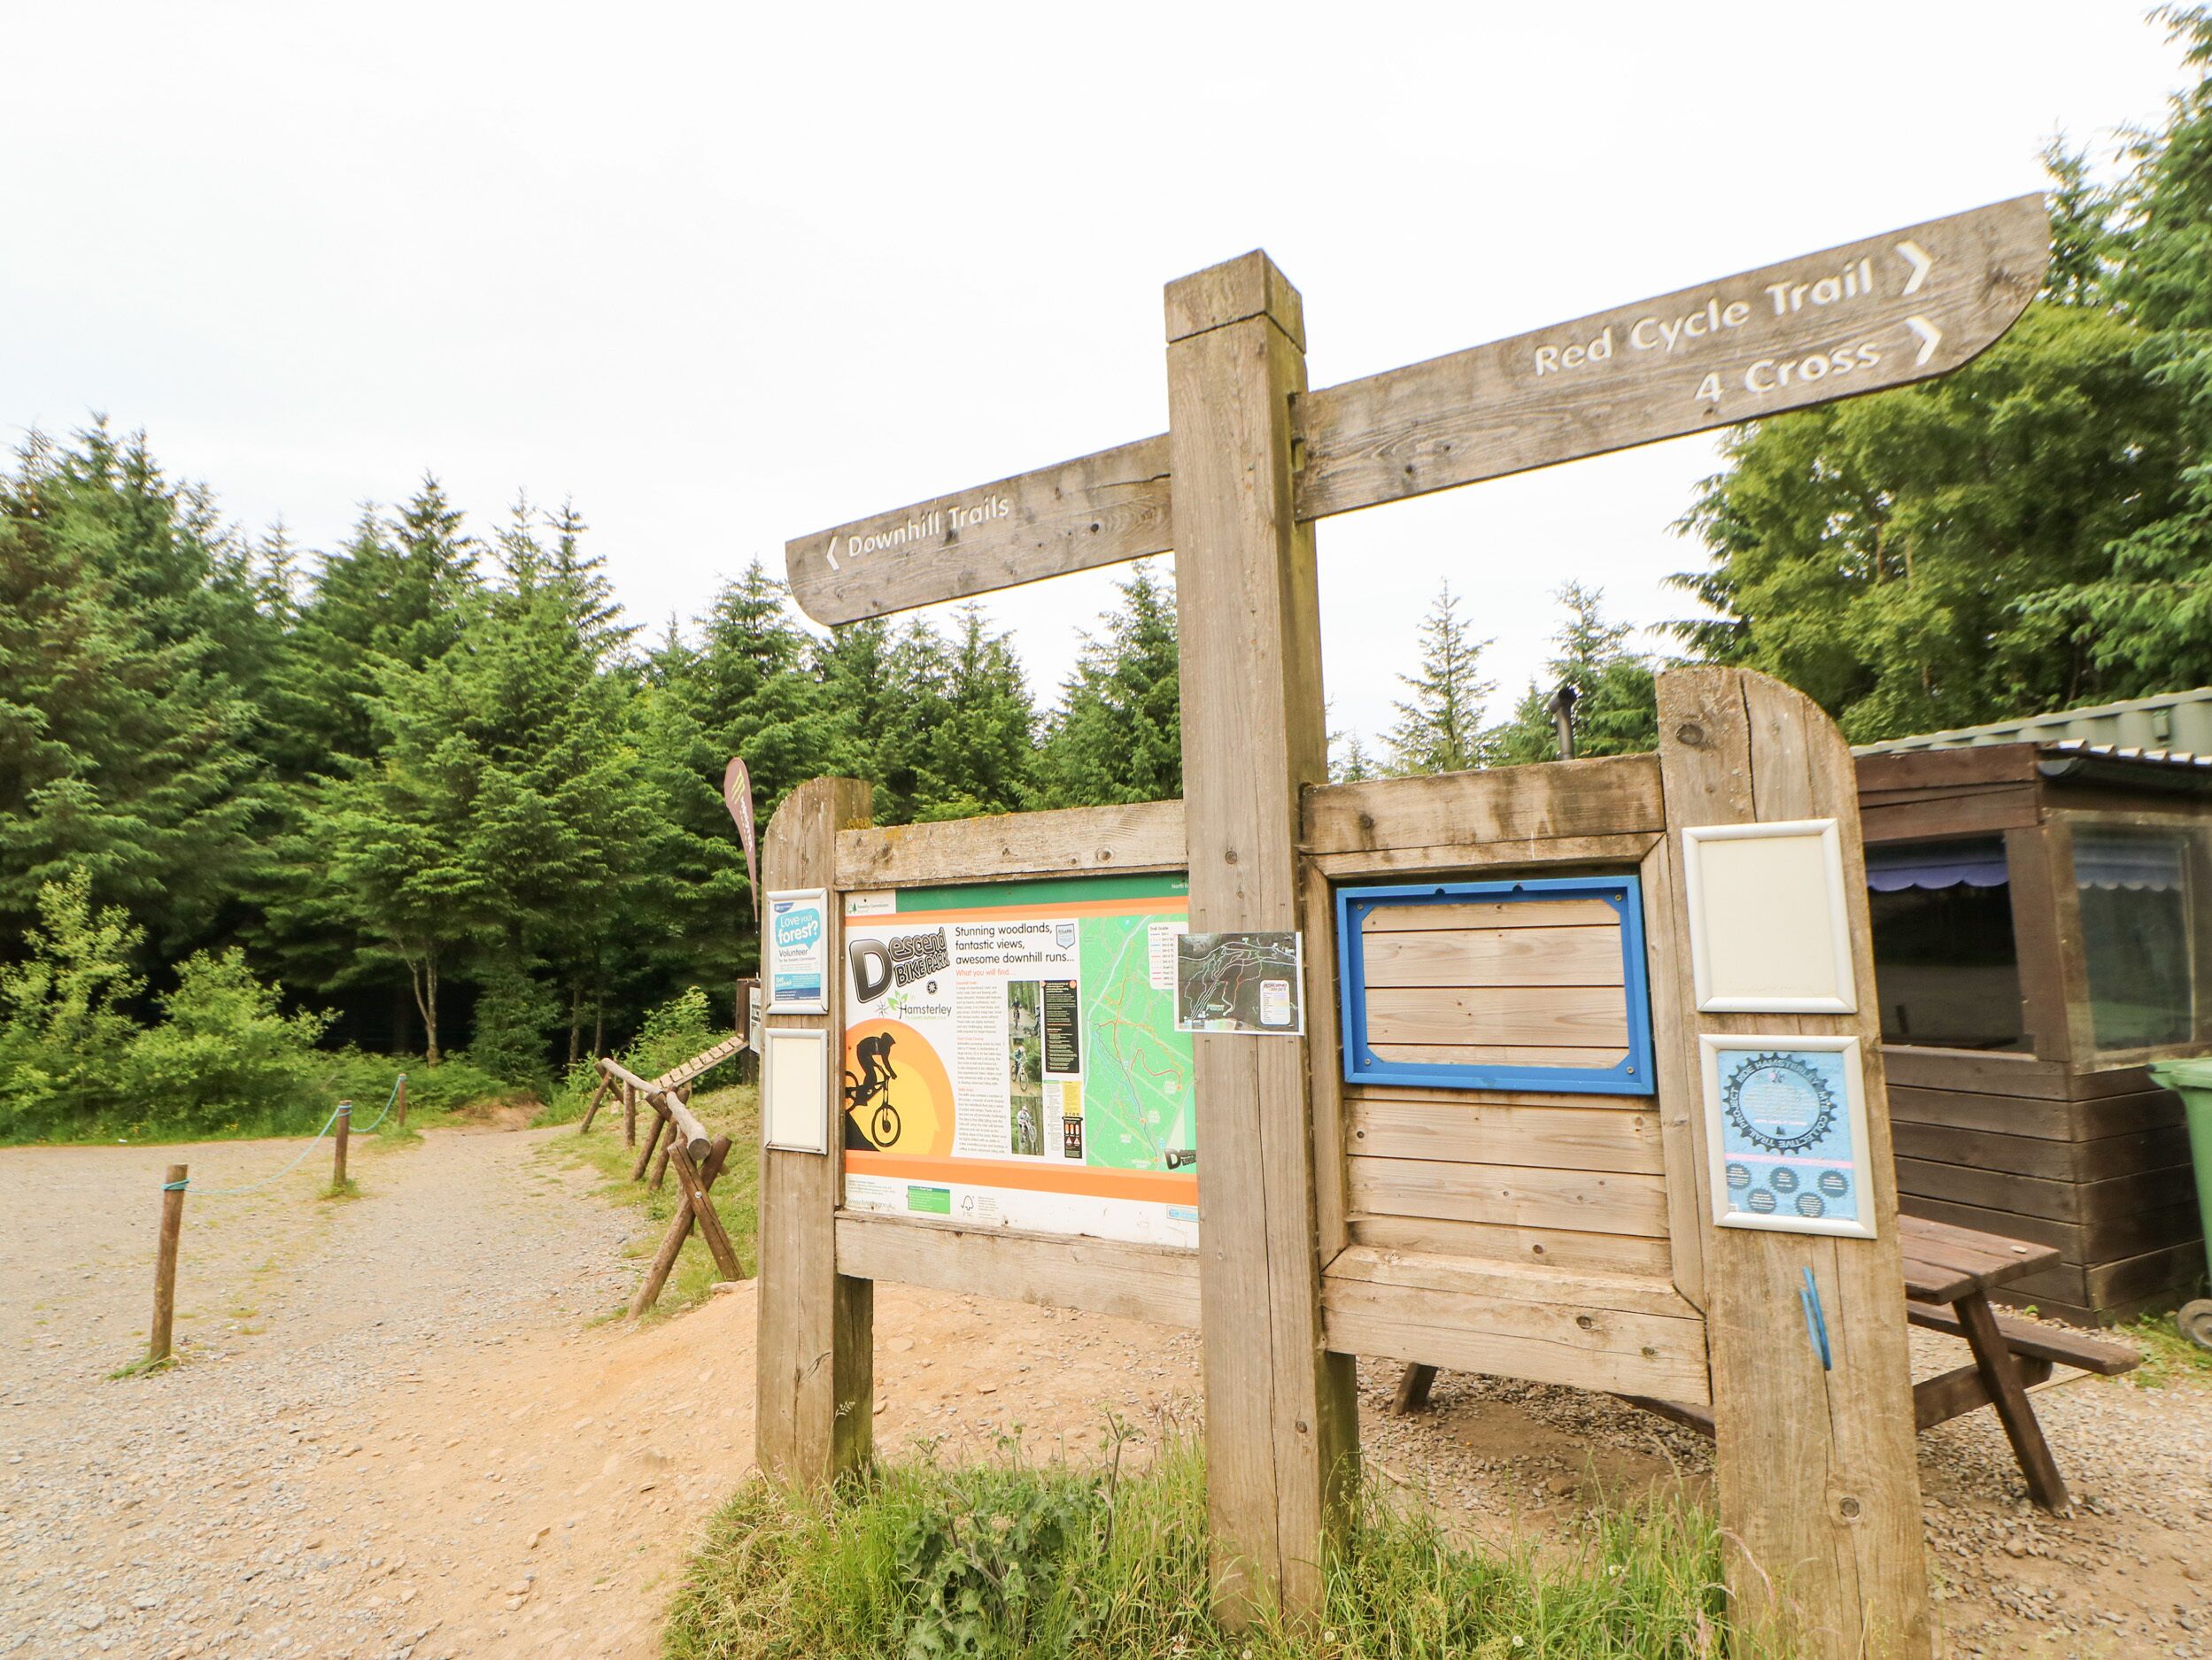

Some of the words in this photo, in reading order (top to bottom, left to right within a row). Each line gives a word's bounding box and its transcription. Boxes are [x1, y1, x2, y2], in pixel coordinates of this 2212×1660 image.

[1535, 327, 1613, 376] Red
[1630, 297, 1751, 353] Cycle
[1765, 257, 1875, 316] Trail
[1694, 372, 1724, 403] 4
[1744, 341, 1881, 396] Cross
[848, 510, 940, 558] Downhill
[947, 494, 1010, 529] Trails
[778, 920, 819, 945] forest?
[780, 915, 800, 929] Love
[800, 915, 813, 925] your
[955, 925, 995, 938] Stunning
[998, 923, 1053, 935] woodlands,
[778, 948, 808, 957] Volunteer
[955, 939, 994, 951] fantastic
[996, 938, 1025, 950] views,
[848, 926, 948, 1005] Descend
[893, 958, 927, 988] BIKE
[924, 950, 951, 975] PARK
[955, 955, 1001, 965] awesome
[1002, 952, 1043, 964] downhill
[1045, 953, 1075, 963] runs...
[899, 1002, 952, 1019] Hamsterley
